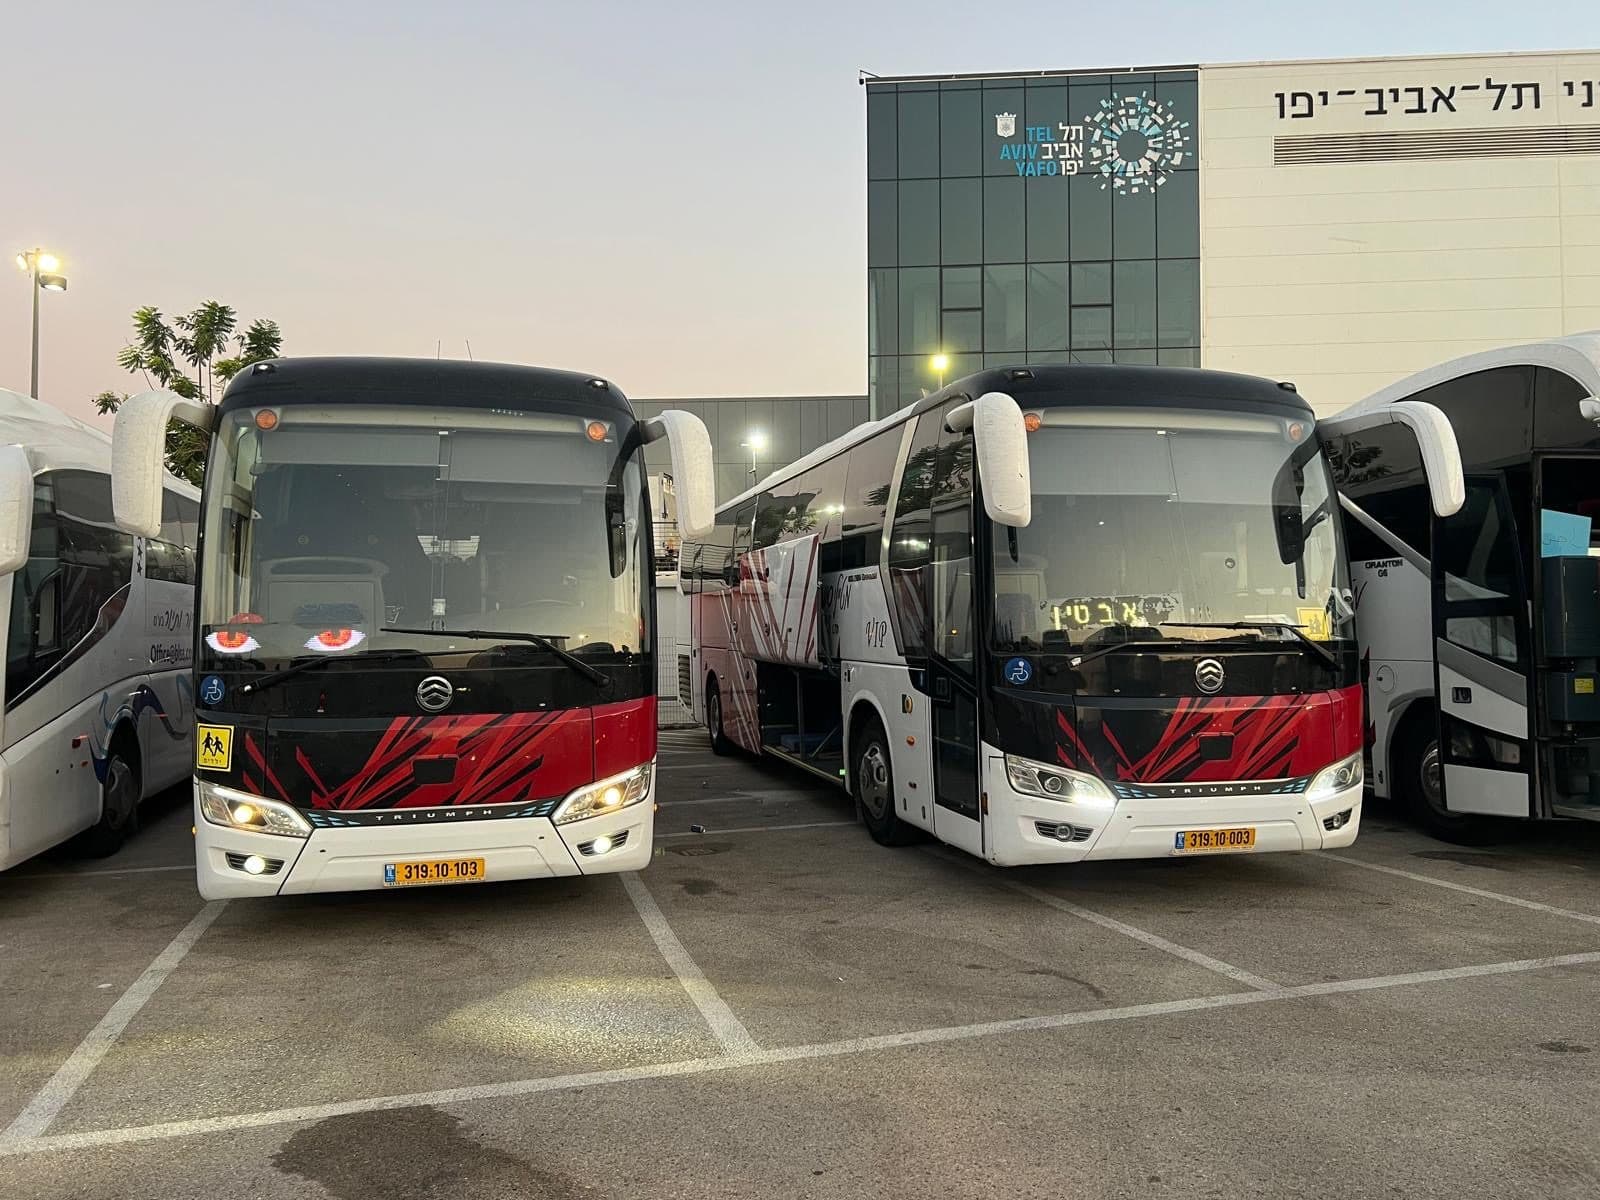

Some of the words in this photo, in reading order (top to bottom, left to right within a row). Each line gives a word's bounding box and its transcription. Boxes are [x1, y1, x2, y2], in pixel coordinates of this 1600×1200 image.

[1563, 80, 1600, 107] ני
[1026, 126, 1056, 142] TEL
[1058, 122, 1084, 141] תל
[1000, 143, 1038, 160] AVIV
[1041, 142, 1083, 159] אביב
[1016, 160, 1057, 177] YAFO
[1060, 159, 1084, 176] יפו
[865, 617, 888, 648] VIP
[1169, 785, 1262, 795] TRIUMPH
[375, 809, 493, 821] TRIUMPH
